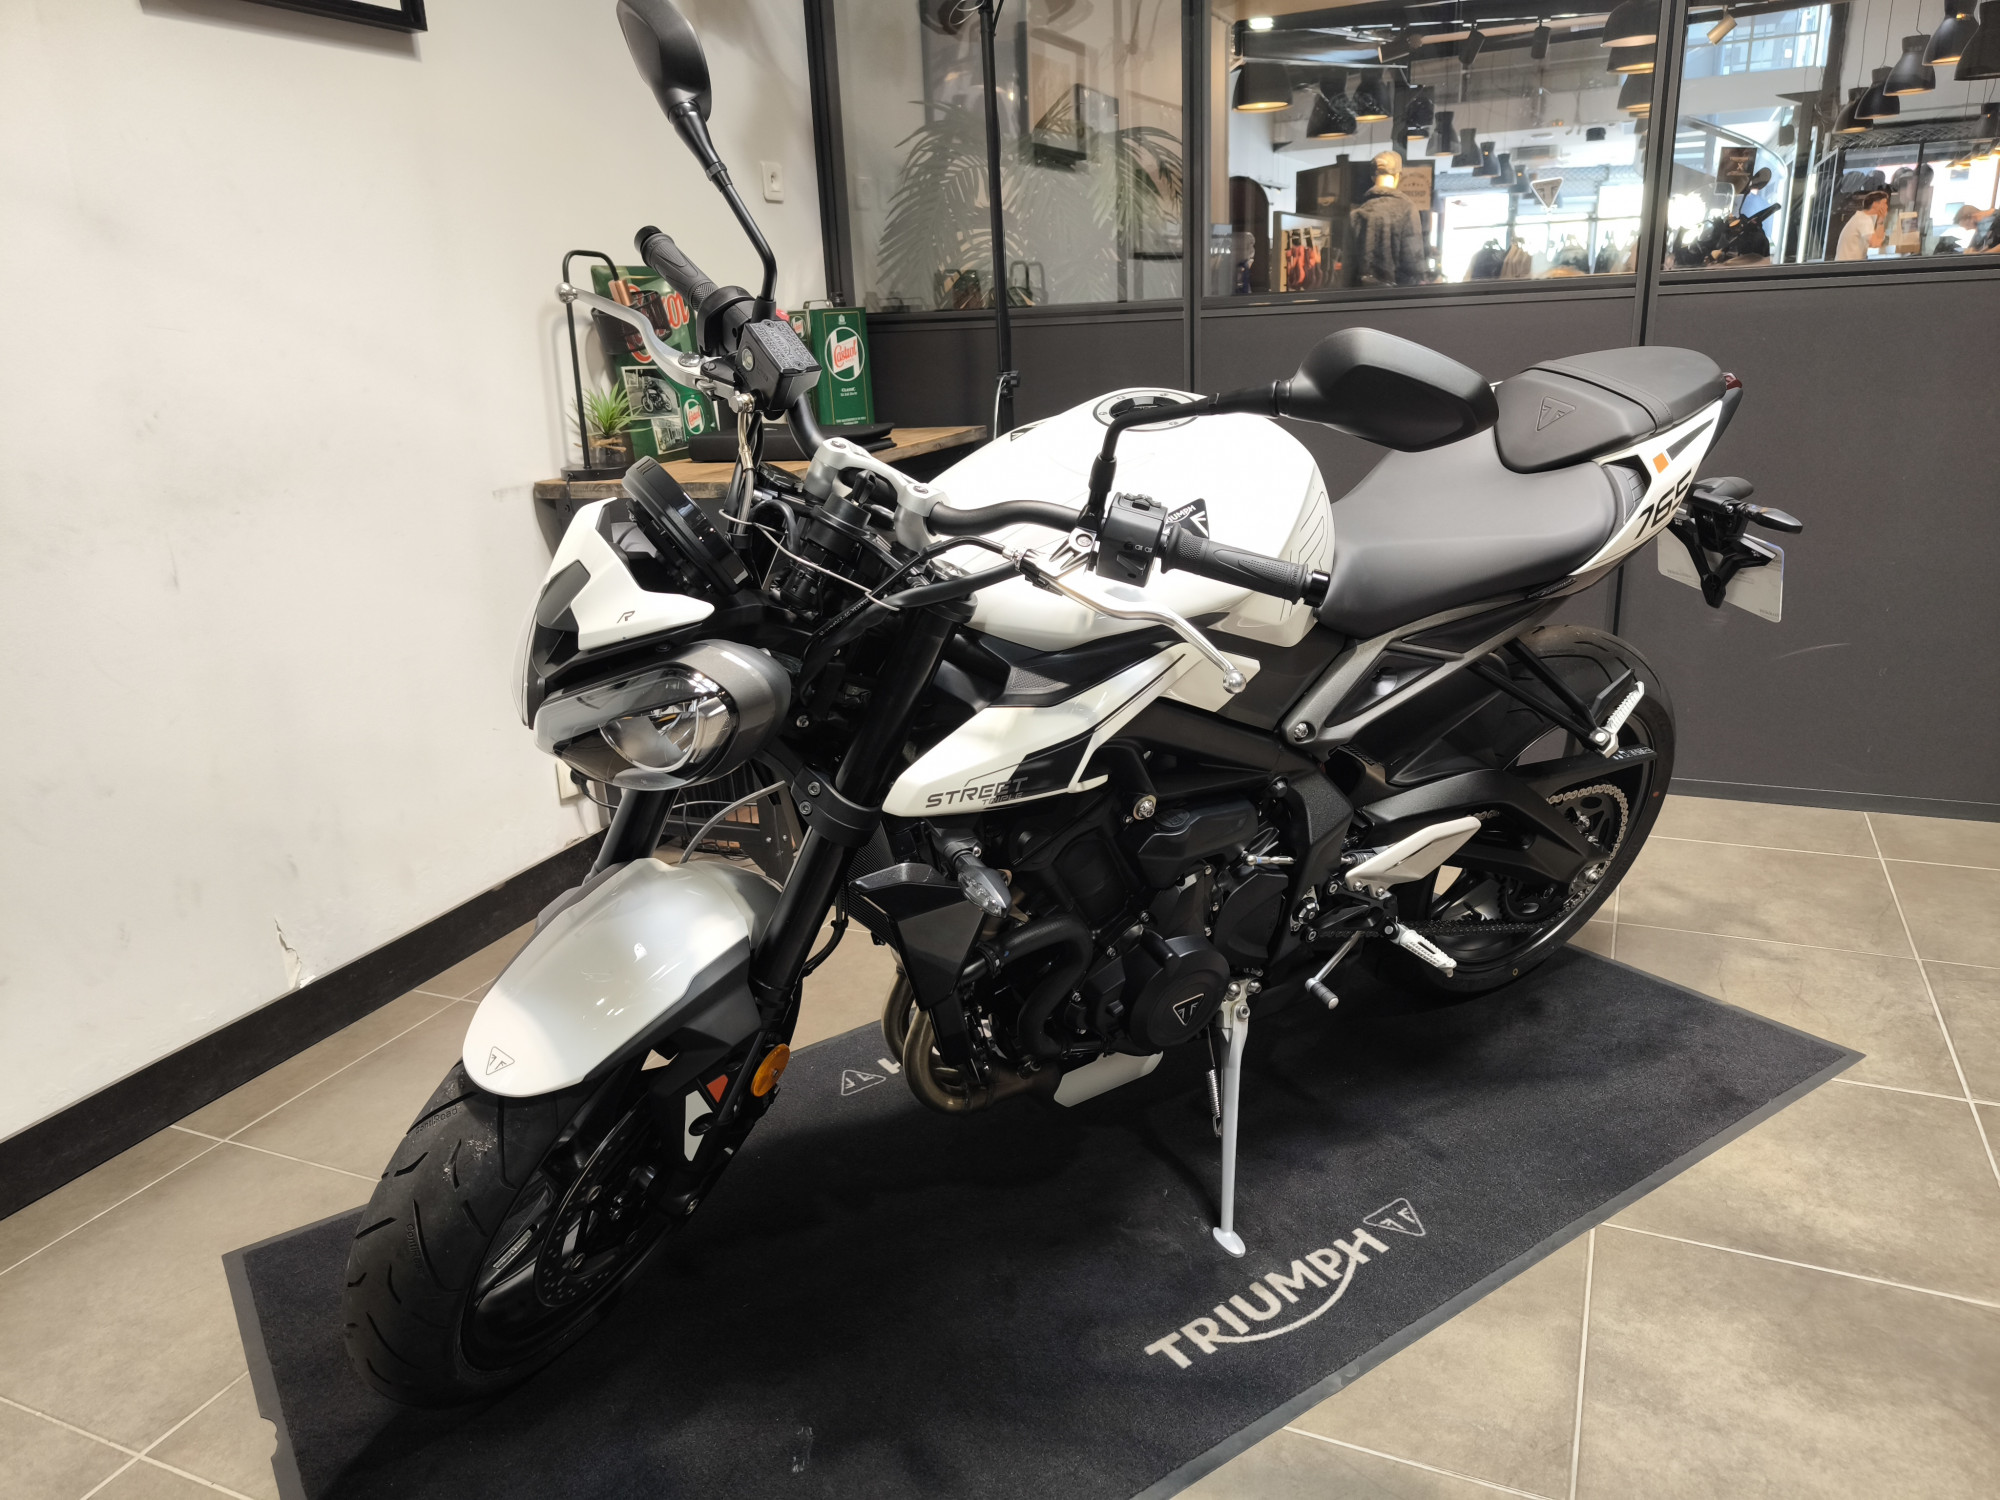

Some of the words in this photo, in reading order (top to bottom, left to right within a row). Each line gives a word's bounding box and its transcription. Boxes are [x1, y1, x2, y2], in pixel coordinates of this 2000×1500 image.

[834, 339, 857, 368] Castrol
[1166, 505, 1197, 525] IUMPH
[1634, 468, 1692, 540] 765
[616, 610, 636, 624] R
[925, 777, 1029, 808] STREET
[981, 791, 1024, 806] TRIPLE
[1144, 1227, 1390, 1369] TRIUMPH
